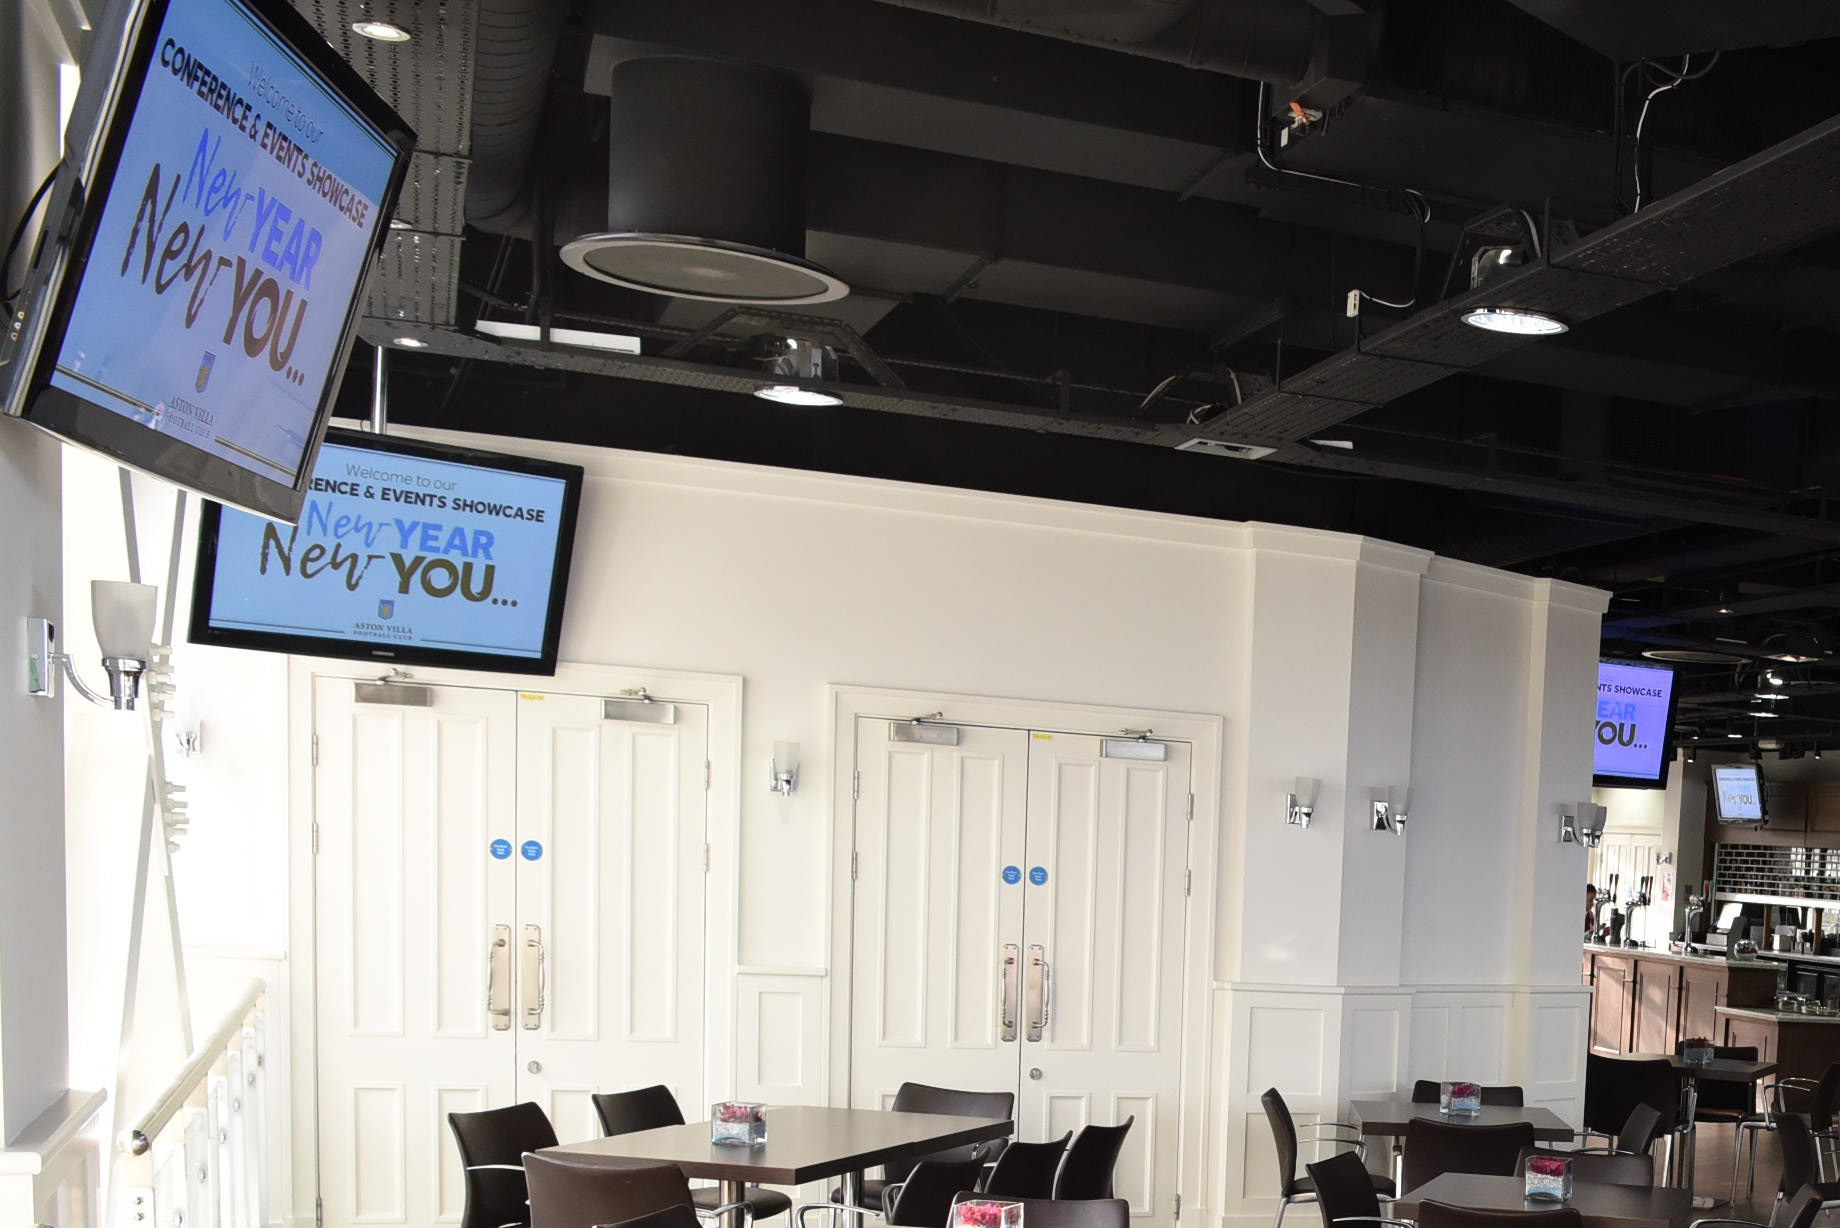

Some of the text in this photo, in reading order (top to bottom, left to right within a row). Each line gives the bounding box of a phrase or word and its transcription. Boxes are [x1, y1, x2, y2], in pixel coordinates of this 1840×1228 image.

[161, 37, 368, 228] CONFERENCE & EVENTS SHOWCASE
[248, 62, 324, 143] Welcome to our
[183, 127, 323, 291] New YEAR
[120, 162, 233, 329] New
[346, 463, 458, 492] Welcome to our
[364, 485, 375, 499] &
[381, 487, 447, 509] EVENTS
[452, 497, 545, 523] SHOWCASE
[260, 521, 386, 592] New
[307, 500, 495, 561] New YEAR
[1614, 685, 1663, 698] SHOWCASE
[1595, 720, 1647, 749] OU...
